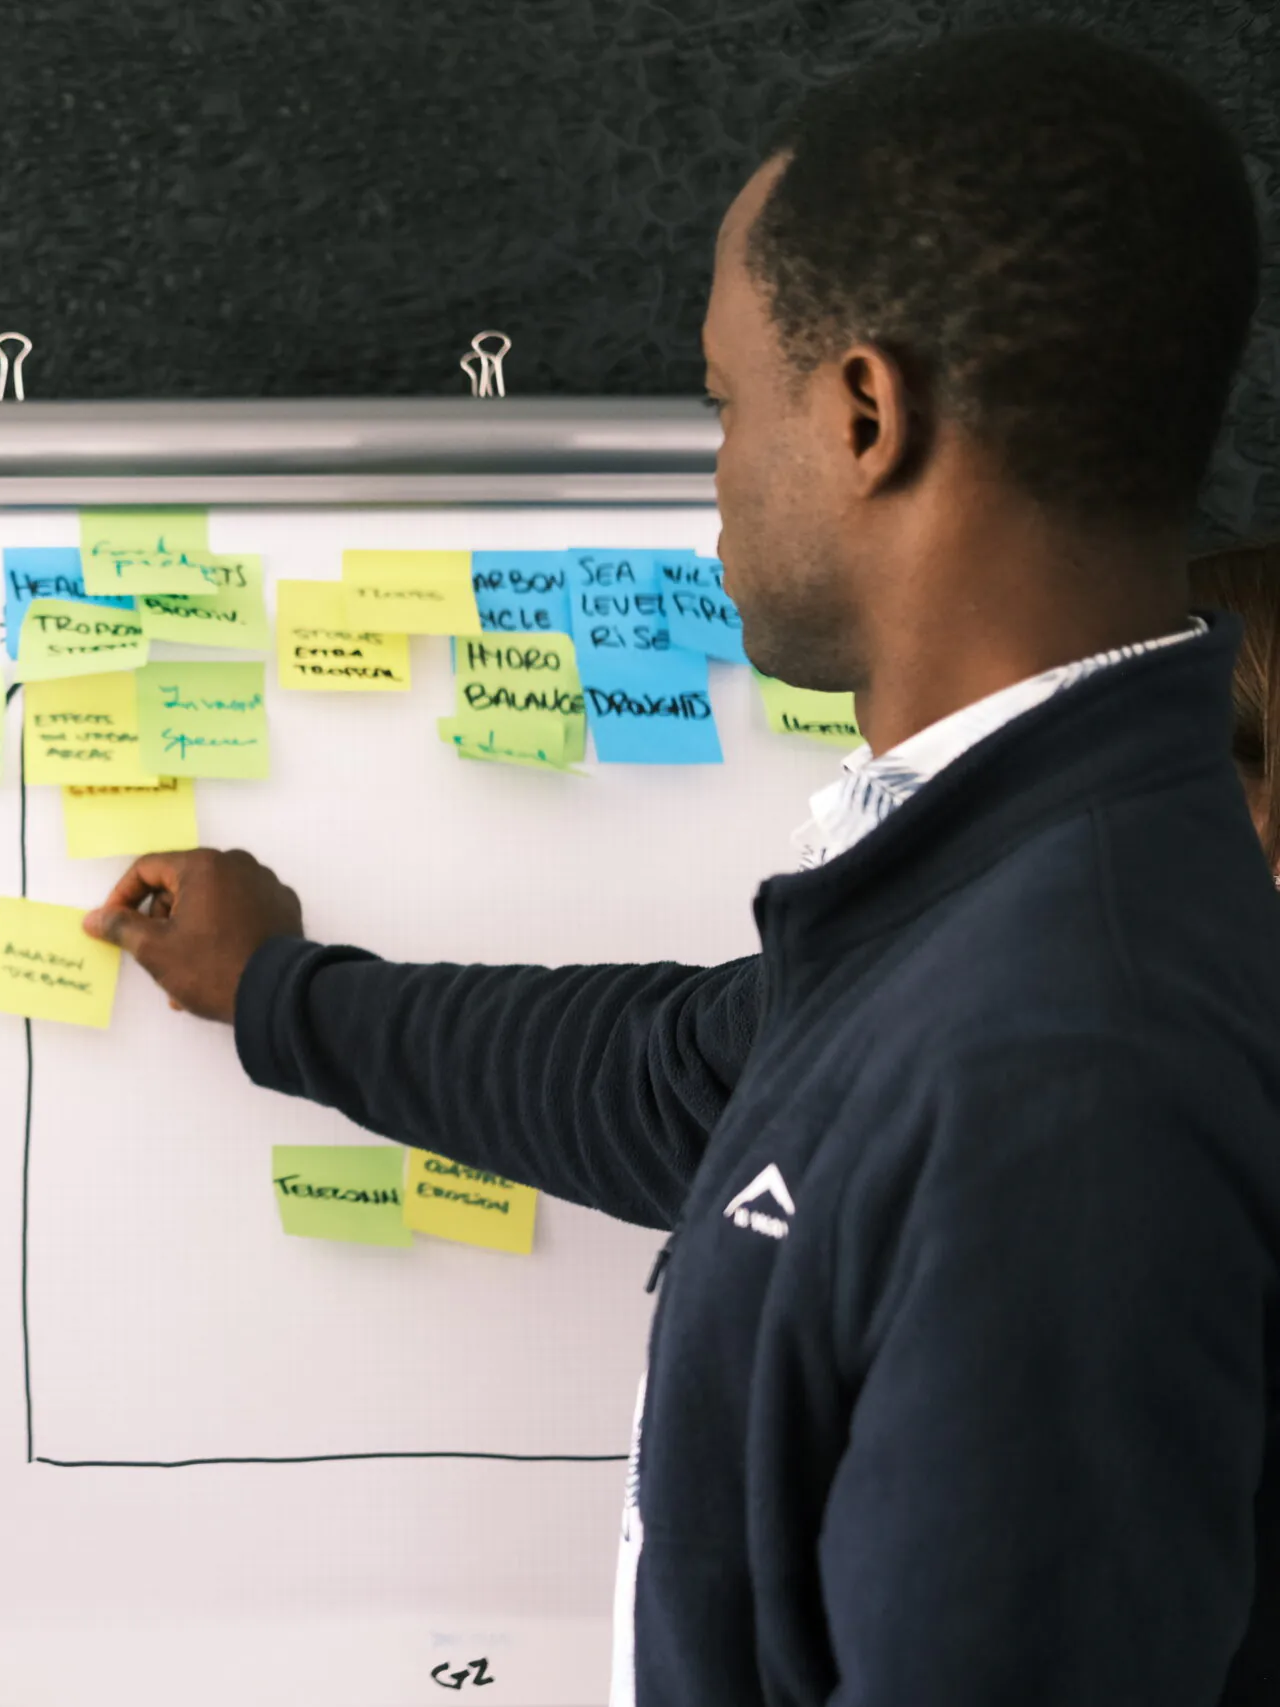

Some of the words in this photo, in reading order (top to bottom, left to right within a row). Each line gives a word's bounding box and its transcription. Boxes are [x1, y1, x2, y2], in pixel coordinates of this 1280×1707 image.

[472, 568, 566, 594] ARBON
[578, 555, 636, 585] SEA
[581, 592, 667, 618] LEVEL
[479, 607, 551, 631] YCLE
[590, 625, 671, 652] RISE
[466, 640, 561, 671] HYDRO
